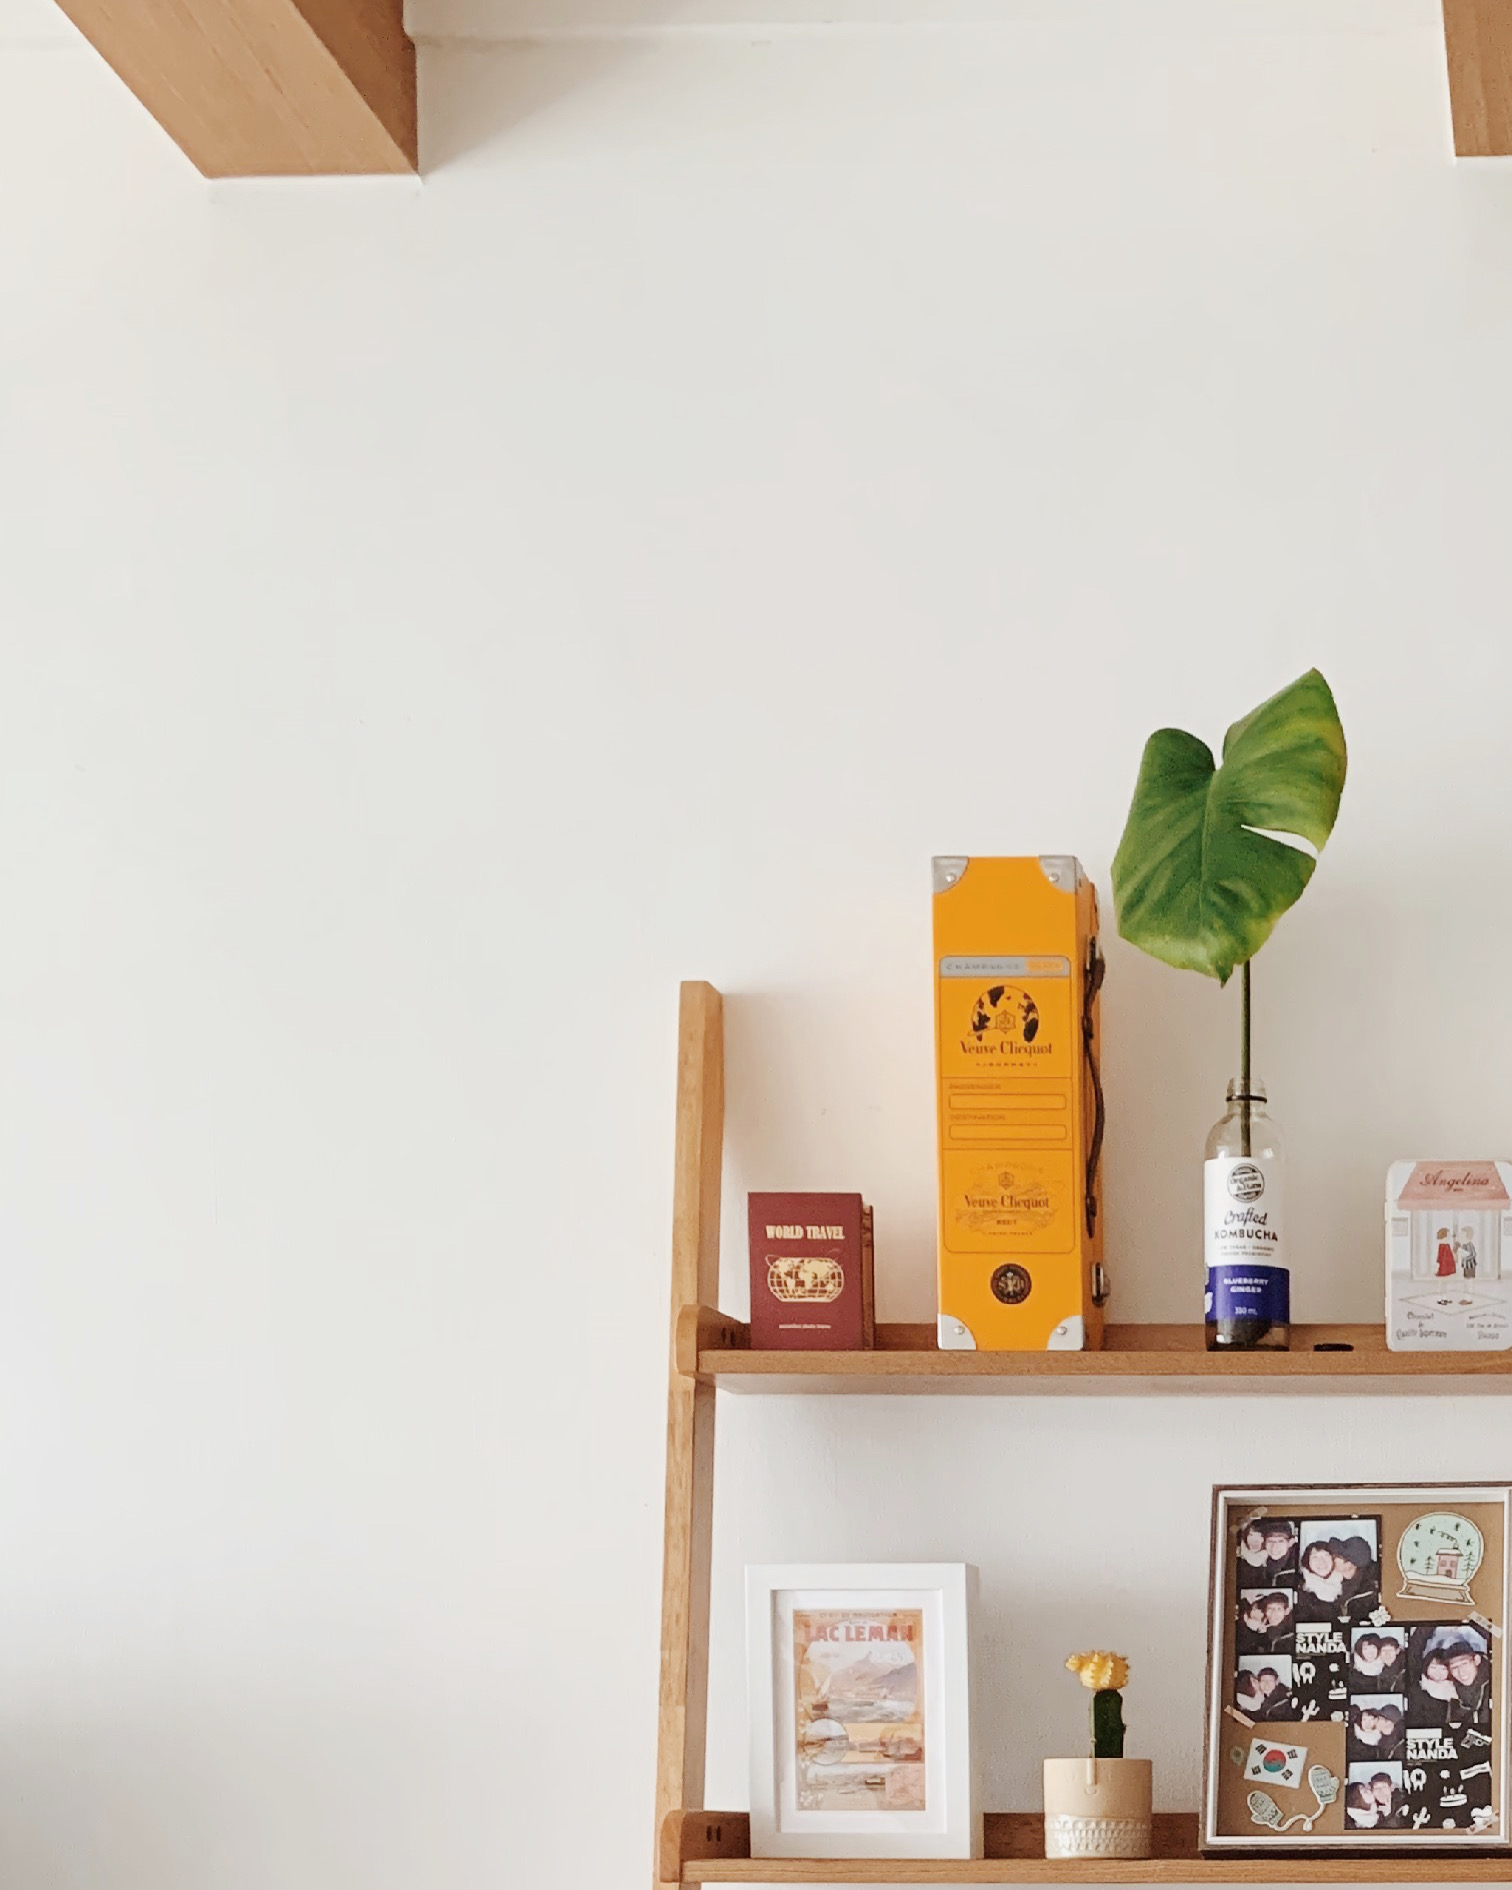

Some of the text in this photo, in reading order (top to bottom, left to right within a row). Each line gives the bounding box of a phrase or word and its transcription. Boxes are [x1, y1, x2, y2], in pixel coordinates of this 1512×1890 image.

[960, 1040, 1053, 1057] Veuve Clicquot
[1419, 1169, 1490, 1192] Angelina
[964, 1195, 1050, 1210] Veuve Clicquot
[1224, 1206, 1268, 1226] Crafted
[765, 1225, 845, 1240] WORLD TRAVEL
[1214, 1228, 1279, 1241] KOMBUCHA
[804, 1624, 914, 1642] LAC LEMAN
[1296, 1632, 1343, 1643] STYLE
[1296, 1642, 1347, 1654] NANDA
[1406, 1738, 1454, 1749] STYLE
[1406, 1748, 1459, 1760] NANDA
